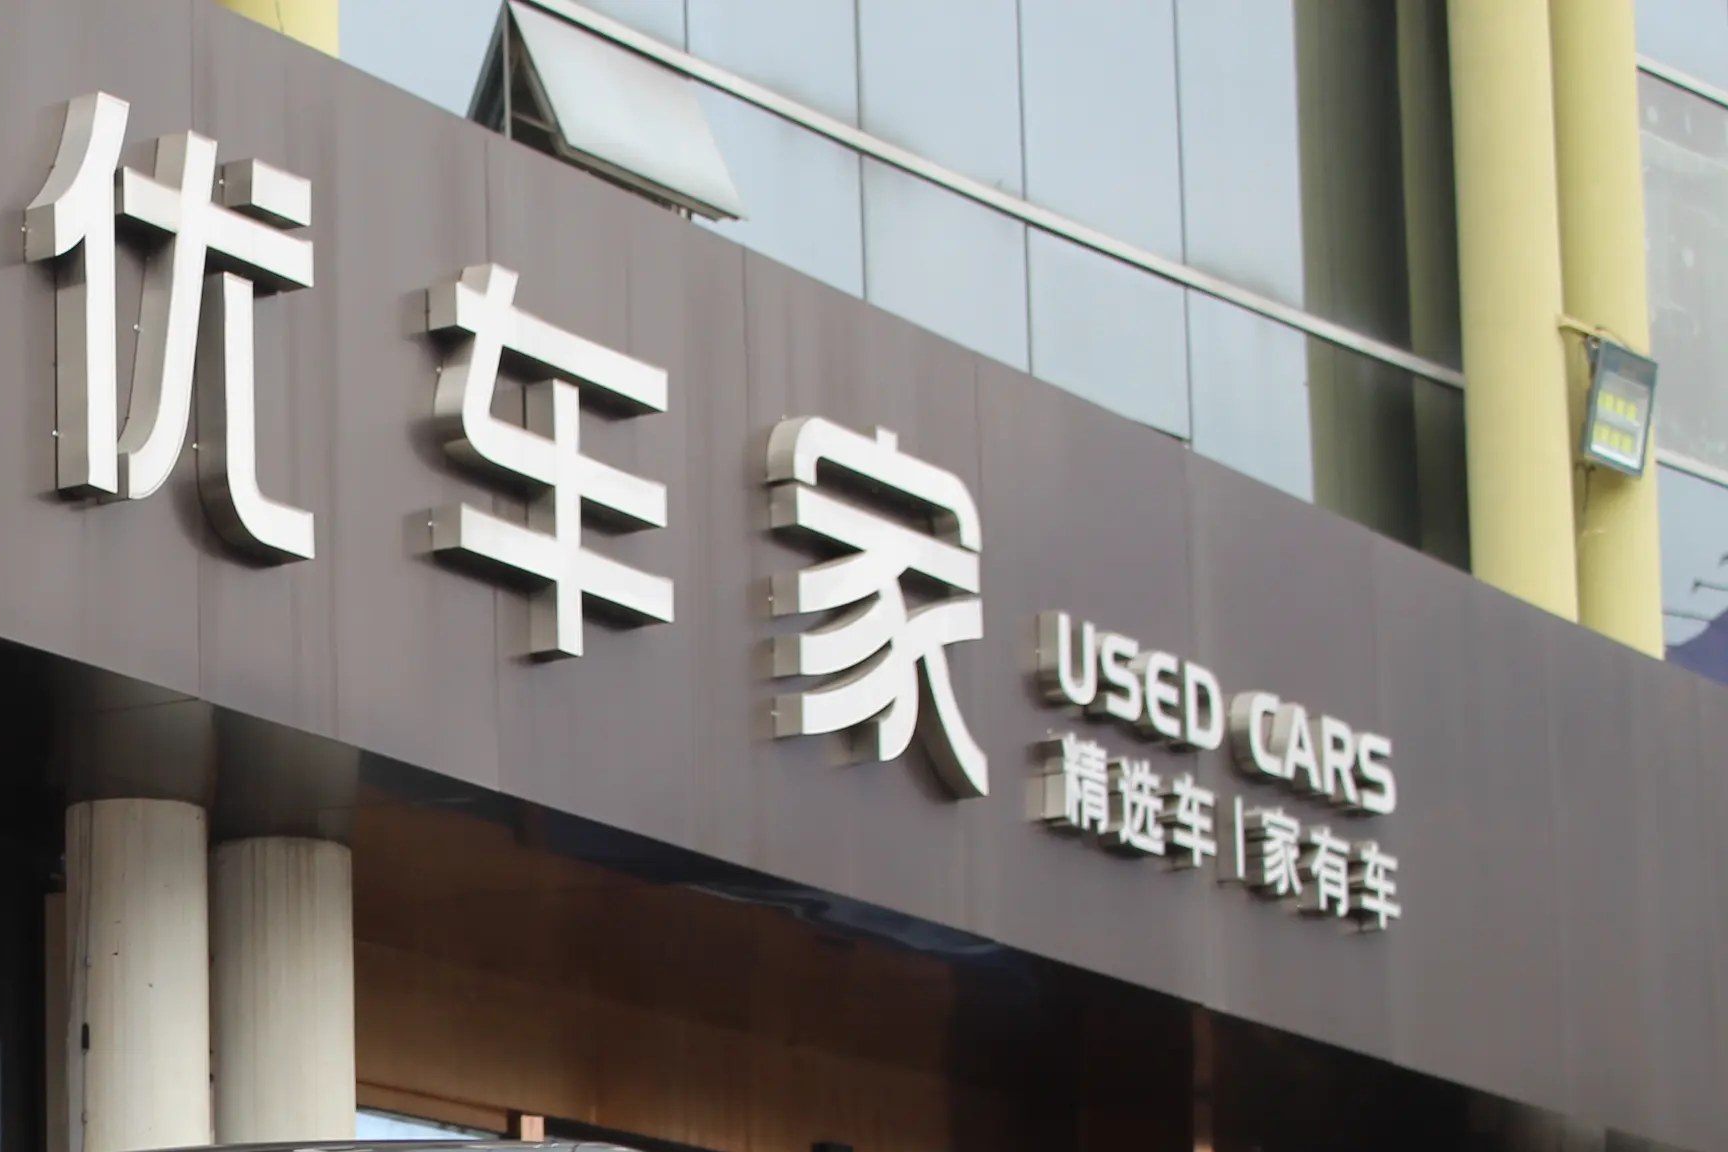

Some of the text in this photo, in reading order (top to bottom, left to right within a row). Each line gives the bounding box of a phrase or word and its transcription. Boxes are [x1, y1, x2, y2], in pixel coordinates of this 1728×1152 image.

[27, 92, 990, 798] 优车家
[1040, 612, 1397, 815] USED CARS
